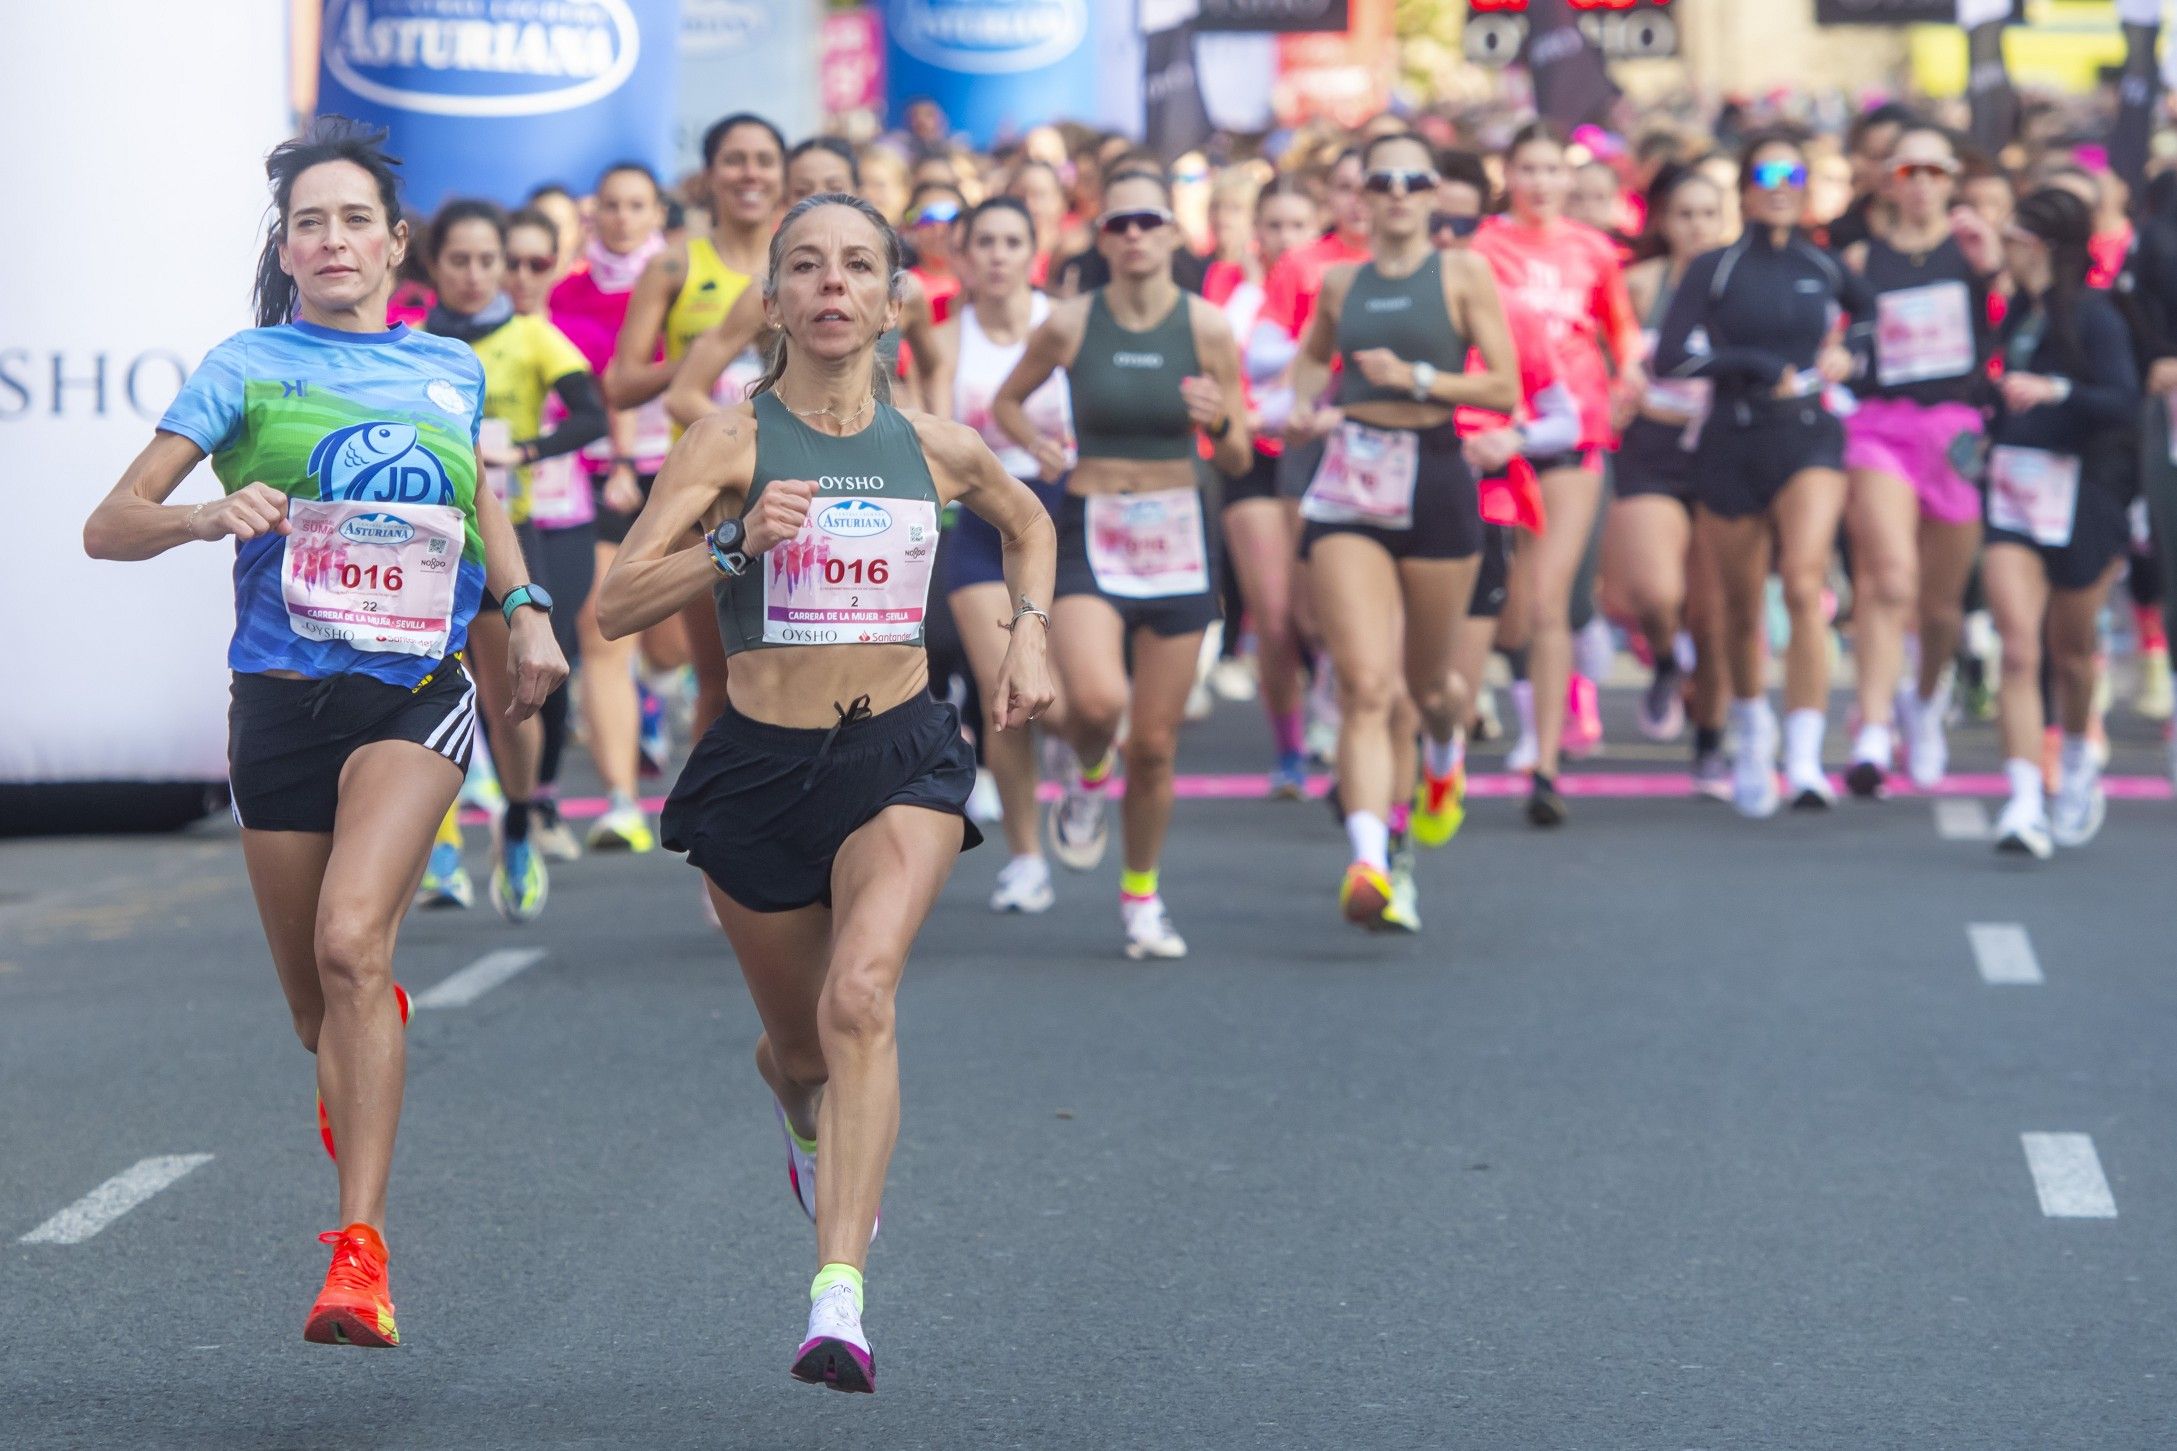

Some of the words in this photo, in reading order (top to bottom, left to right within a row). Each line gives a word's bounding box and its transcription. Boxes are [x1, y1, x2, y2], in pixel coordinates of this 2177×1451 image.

[373, 466, 431, 502] JD
[818, 475, 885, 490] OYSHO
[823, 513, 888, 528] ASTURIANA
[344, 521, 409, 539] ASTURIANA
[341, 563, 404, 591] 016
[824, 558, 889, 585] 016
[362, 601, 378, 612] 22
[851, 596, 858, 607] 2
[307, 609, 343, 620] CARRERA
[344, 613, 354, 621] DE
[355, 615, 367, 623] LA
[367, 617, 391, 626] MUJER
[395, 619, 425, 629] SEVILLA
[788, 611, 825, 621] CARRERA
[827, 612, 838, 621] DE
[840, 612, 850, 621] LA
[851, 612, 879, 621] MUJER
[304, 622, 355, 642] OYSHO
[782, 628, 838, 642] OYSHO
